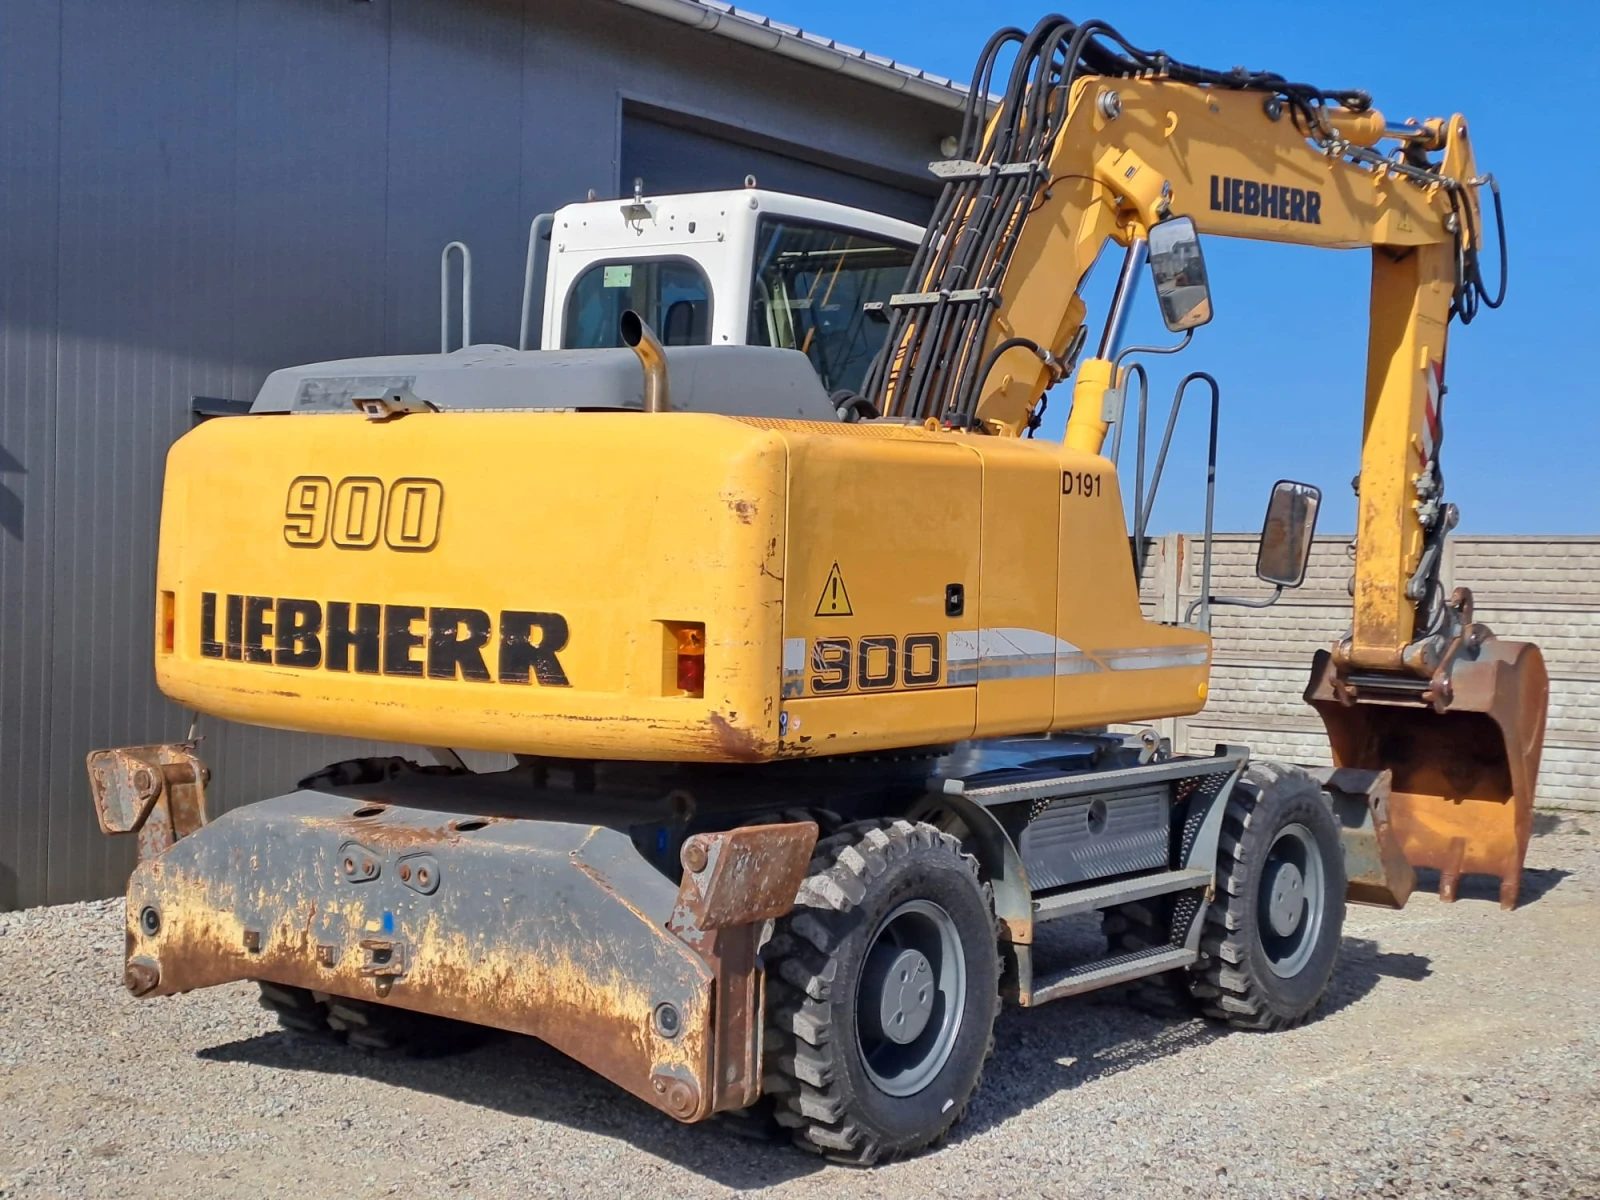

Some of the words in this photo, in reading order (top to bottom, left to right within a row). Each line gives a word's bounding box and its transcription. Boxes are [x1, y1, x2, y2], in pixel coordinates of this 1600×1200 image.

[1210, 174, 1321, 225] LIEBHERR
[284, 475, 444, 553] 900
[1062, 470, 1101, 498] D191
[201, 592, 573, 687] LIEBHERR
[811, 632, 942, 694] 900
